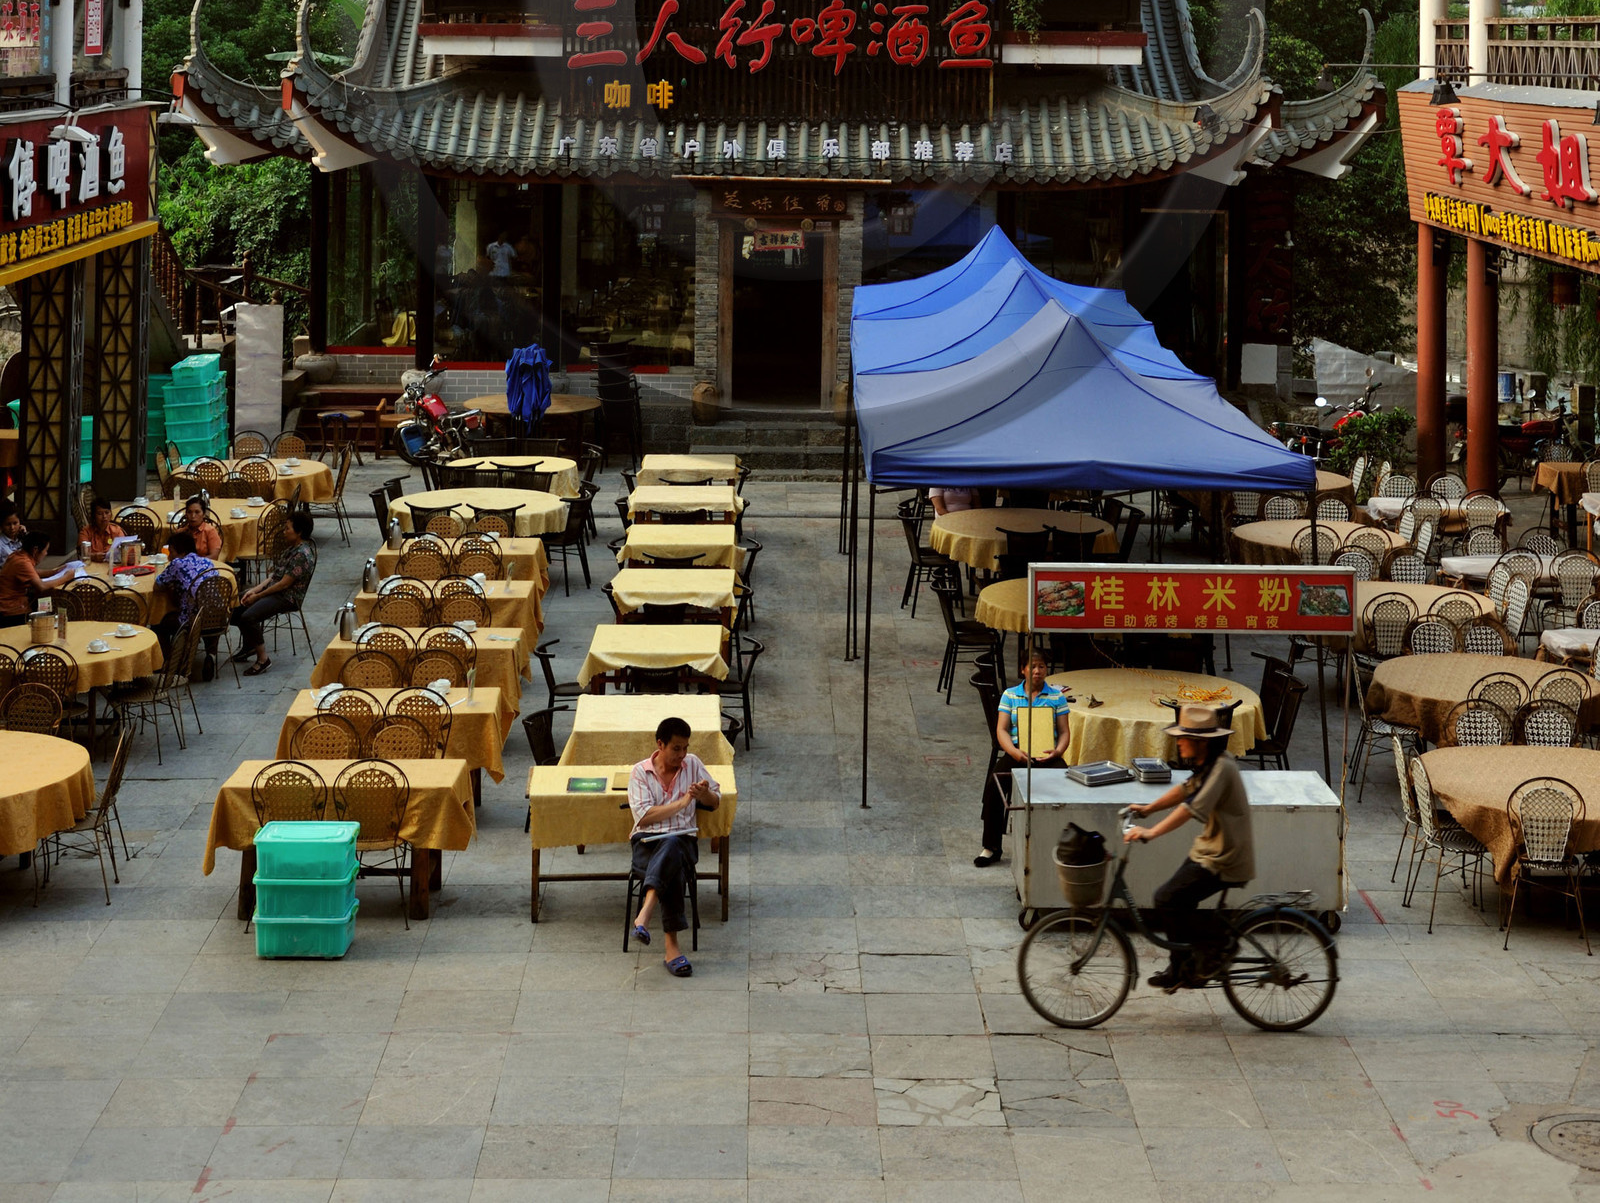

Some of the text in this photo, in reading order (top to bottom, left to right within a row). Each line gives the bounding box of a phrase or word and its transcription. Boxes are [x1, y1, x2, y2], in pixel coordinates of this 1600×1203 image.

[604, 80, 674, 110] 咖啡
[558, 137, 1014, 162] 广东省户外俱乐部推荐店
[1436, 108, 1595, 209] 覃大姐
[8, 126, 126, 221] 傅啤酒鱼
[723, 190, 831, 212] 美味佳肴
[758, 231, 800, 246] 吉祥如意
[1090, 576, 1292, 611] 桂林米粉
[1103, 614, 1279, 628] 自助烧烤 烤鱼 宵夜
